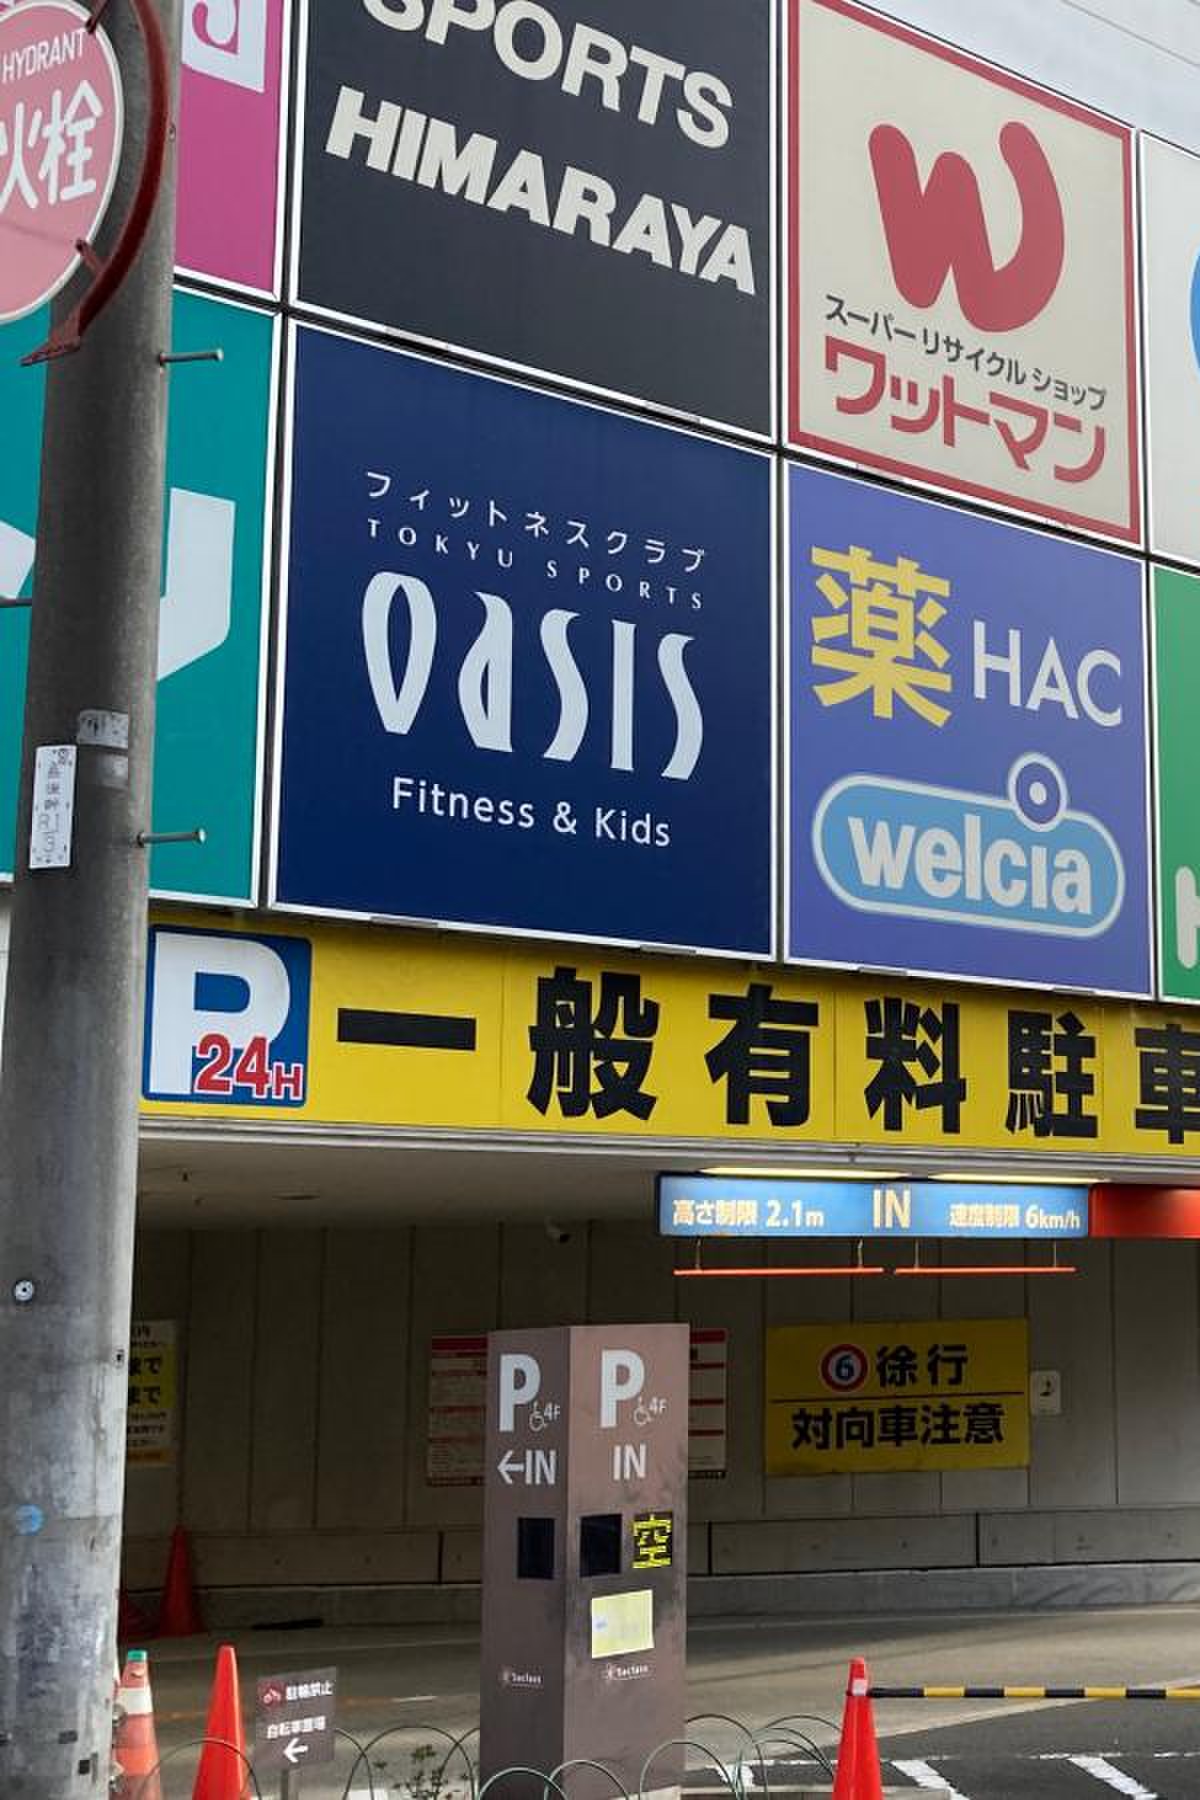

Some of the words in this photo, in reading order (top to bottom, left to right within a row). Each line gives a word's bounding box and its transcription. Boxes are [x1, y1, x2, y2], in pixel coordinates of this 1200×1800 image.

[2, 27, 86, 83] HYDRANT
[0, 80, 104, 212] 火栓
[325, 86, 756, 296] HIMARAYA
[824, 335, 1106, 484] ワットマン
[365, 471, 705, 572] フィットネスクラブ
[367, 518, 514, 569] TOKYU
[547, 558, 703, 610] SPORTS
[810, 544, 952, 727] 薬
[973, 620, 1123, 728] HAC
[392, 776, 535, 829] Fitness
[553, 802, 577, 835] &
[595, 806, 672, 848] Kids
[848, 813, 1093, 916] welcia
[149, 931, 291, 1095] P
[194, 1032, 304, 1100] 24H
[765, 1199, 825, 1229] 2.1m
[872, 1188, 911, 1229] IN
[1024, 1203, 1081, 1231] 6km/h
[499, 1353, 542, 1433] P
[600, 1348, 646, 1429] P
[837, 1355, 856, 1382] 6
[876, 1344, 968, 1386] 徐行
[543, 1402, 561, 1421] 4F
[649, 1397, 668, 1415] 4F
[791, 1402, 1006, 1450] 対向車注意
[524, 1449, 557, 1486] IN
[612, 1443, 647, 1481] IN
[632, 1513, 672, 1569] 空
